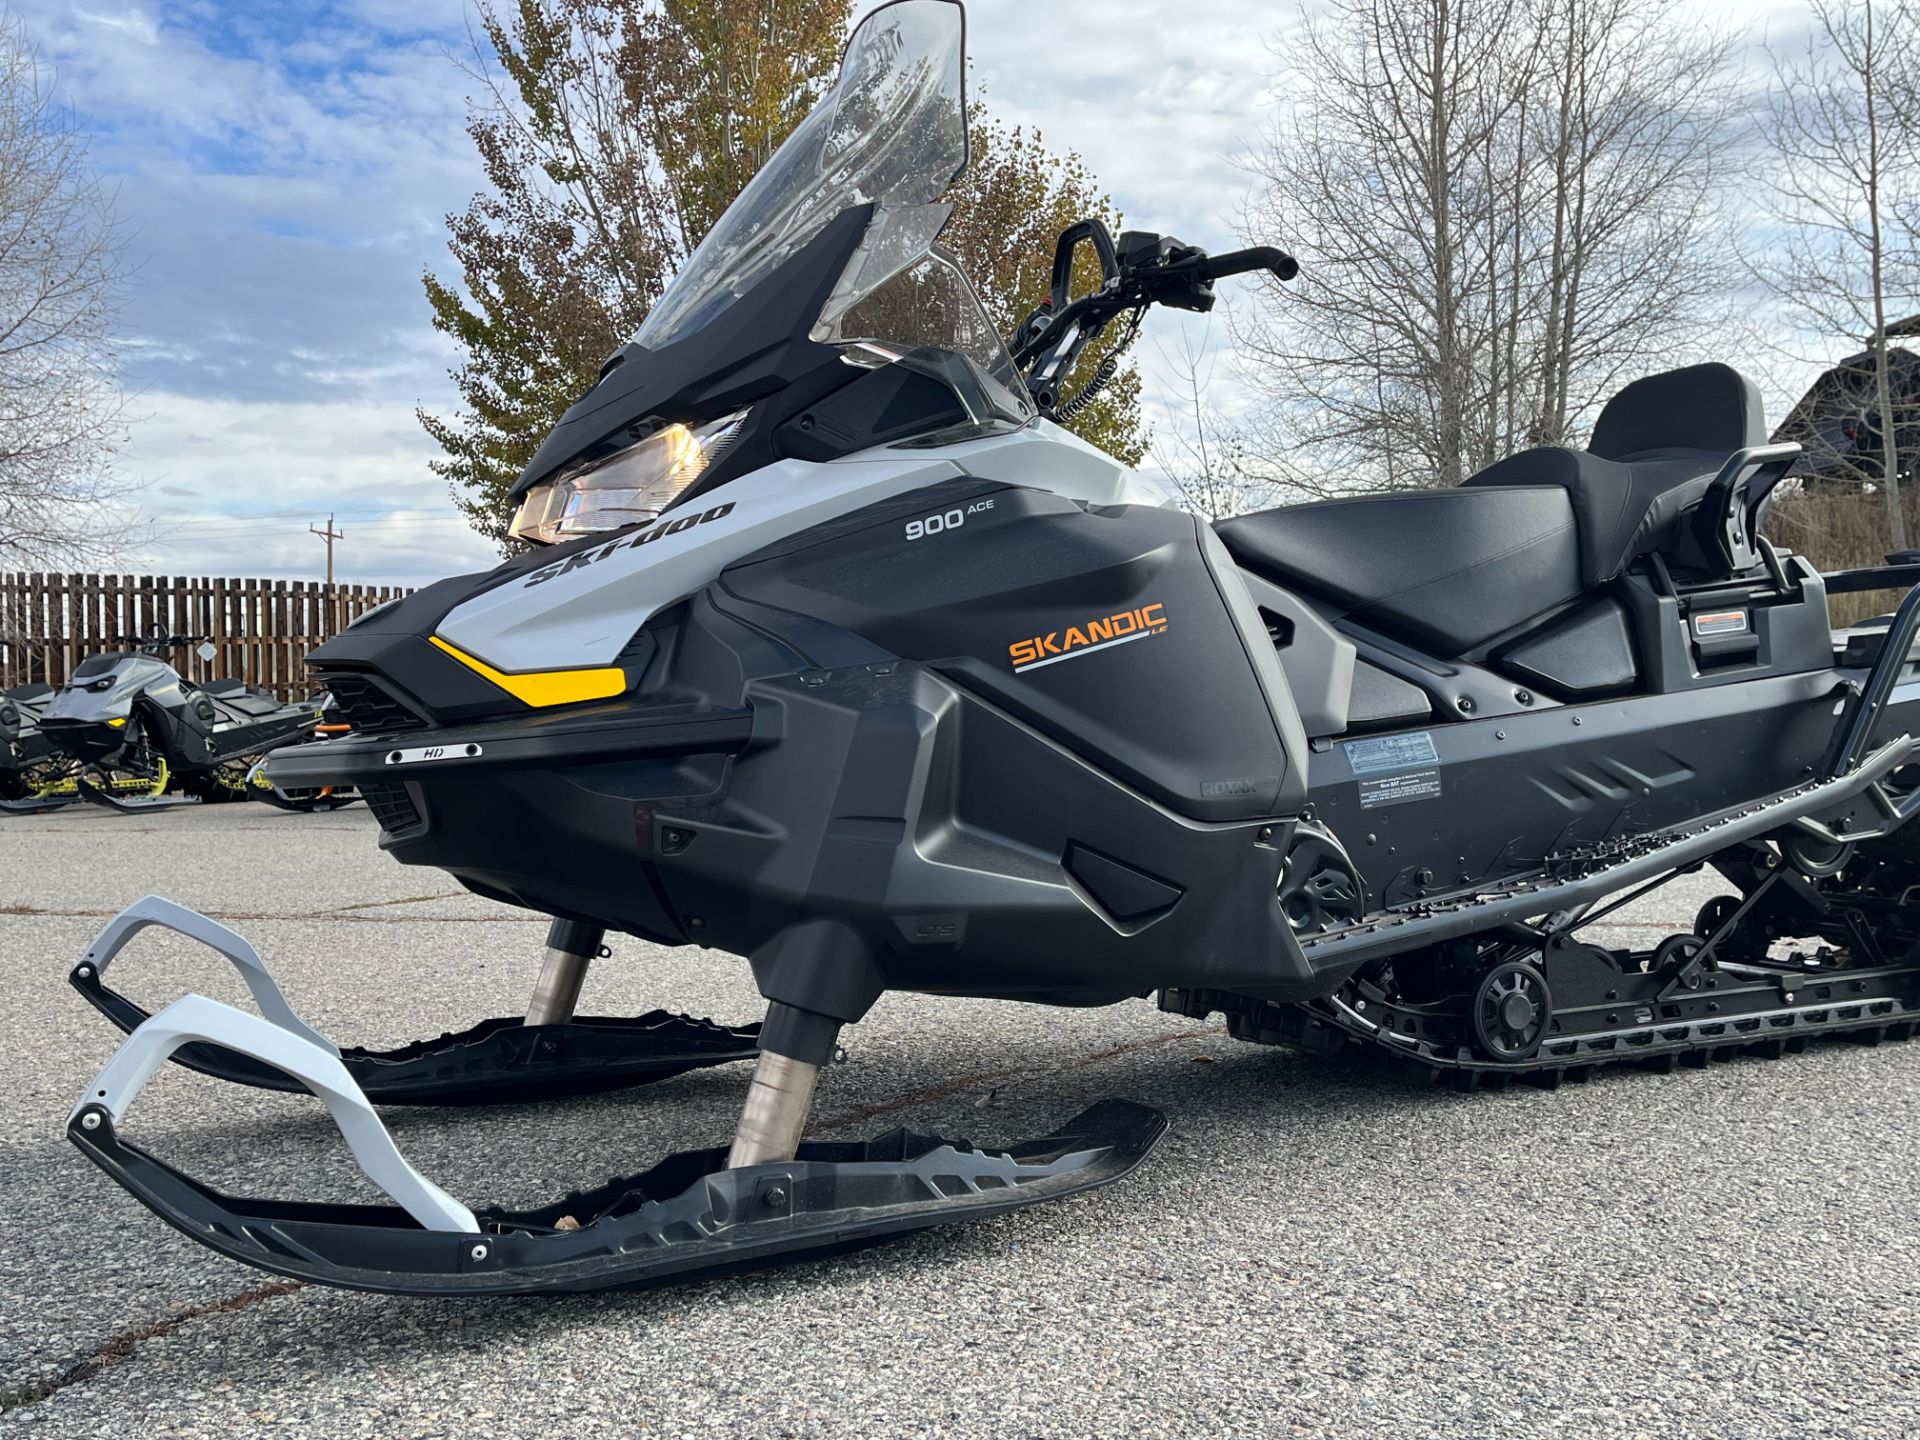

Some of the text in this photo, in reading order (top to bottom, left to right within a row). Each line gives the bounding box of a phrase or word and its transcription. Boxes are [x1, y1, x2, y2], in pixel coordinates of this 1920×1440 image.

[905, 499, 995, 541] 900 ACE
[1008, 602, 1168, 666] SKANDIC
[1151, 625, 1169, 635] LE
[423, 747, 444, 759] HD
[1201, 780, 1257, 796] ROTAX
